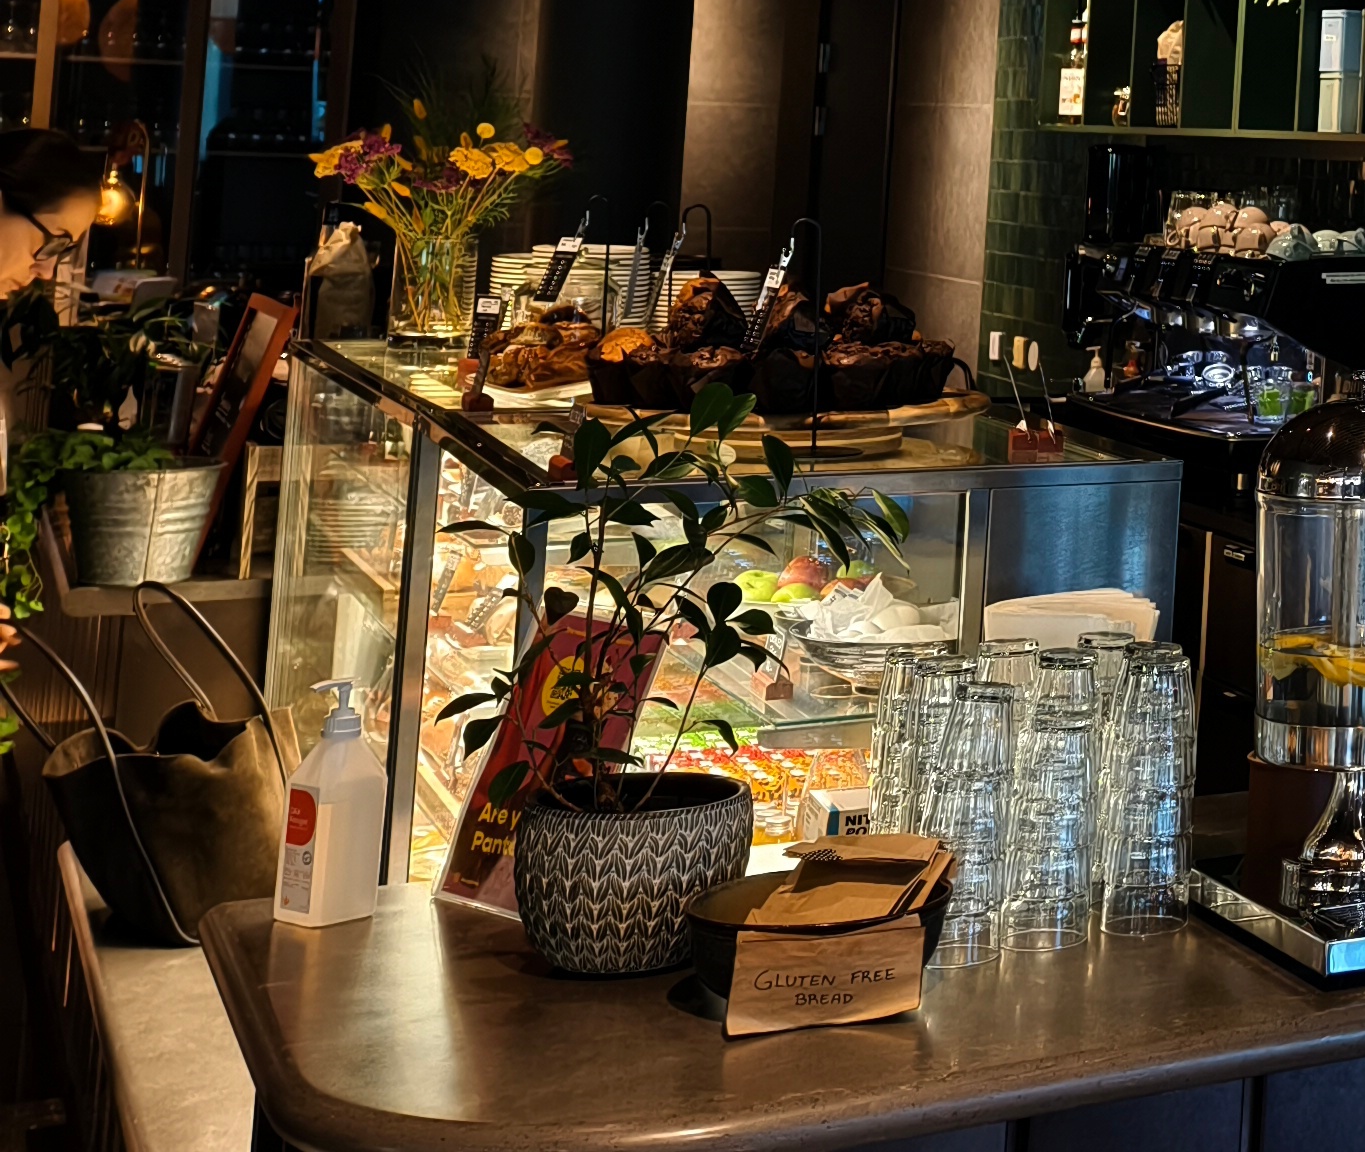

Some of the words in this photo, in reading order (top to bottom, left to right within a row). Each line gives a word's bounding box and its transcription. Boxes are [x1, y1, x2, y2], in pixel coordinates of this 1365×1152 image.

[478, 802, 509, 825] Are
[470, 830, 516, 857] Pant
[754, 969, 836, 991] GLUTEN
[850, 967, 896, 985] FREE
[794, 993, 854, 1006] BREAD
